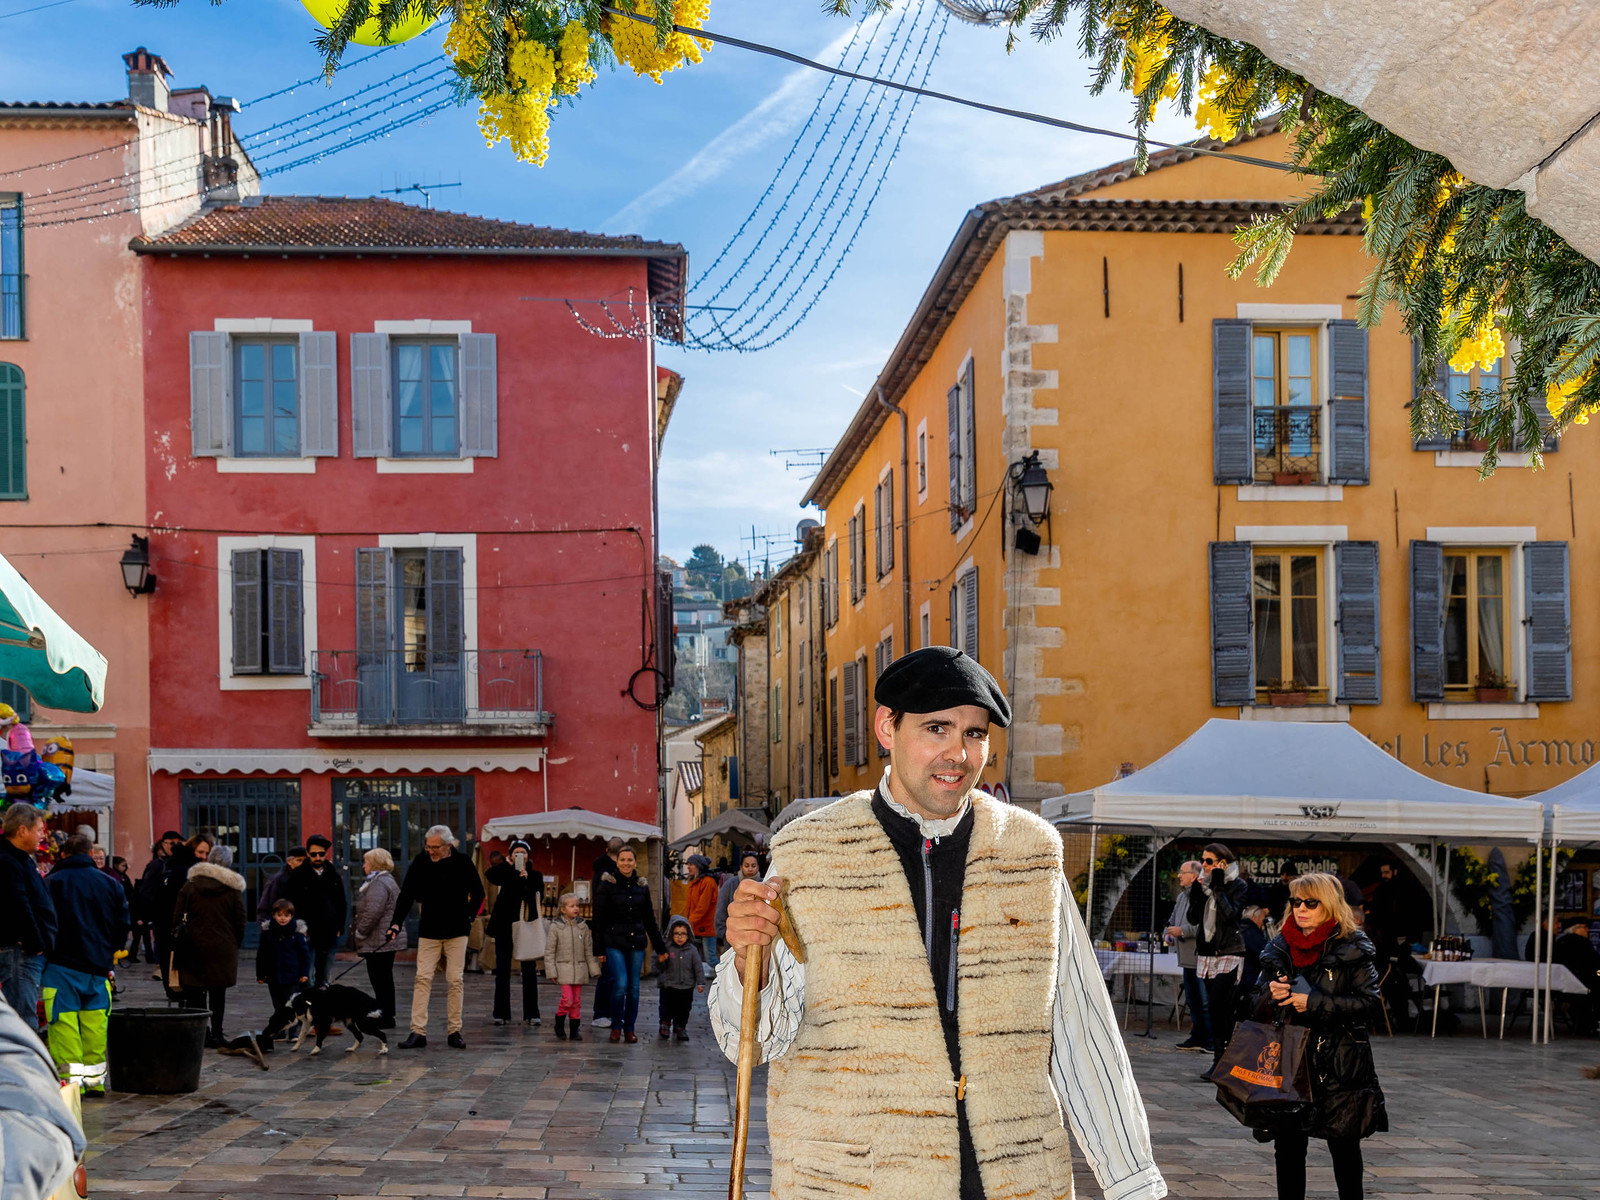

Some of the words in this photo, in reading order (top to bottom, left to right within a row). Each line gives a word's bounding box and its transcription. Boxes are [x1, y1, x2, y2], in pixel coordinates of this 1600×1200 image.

[1422, 733, 1470, 768] les
[1487, 727, 1600, 768] Armo
[1260, 857, 1275, 874] de
